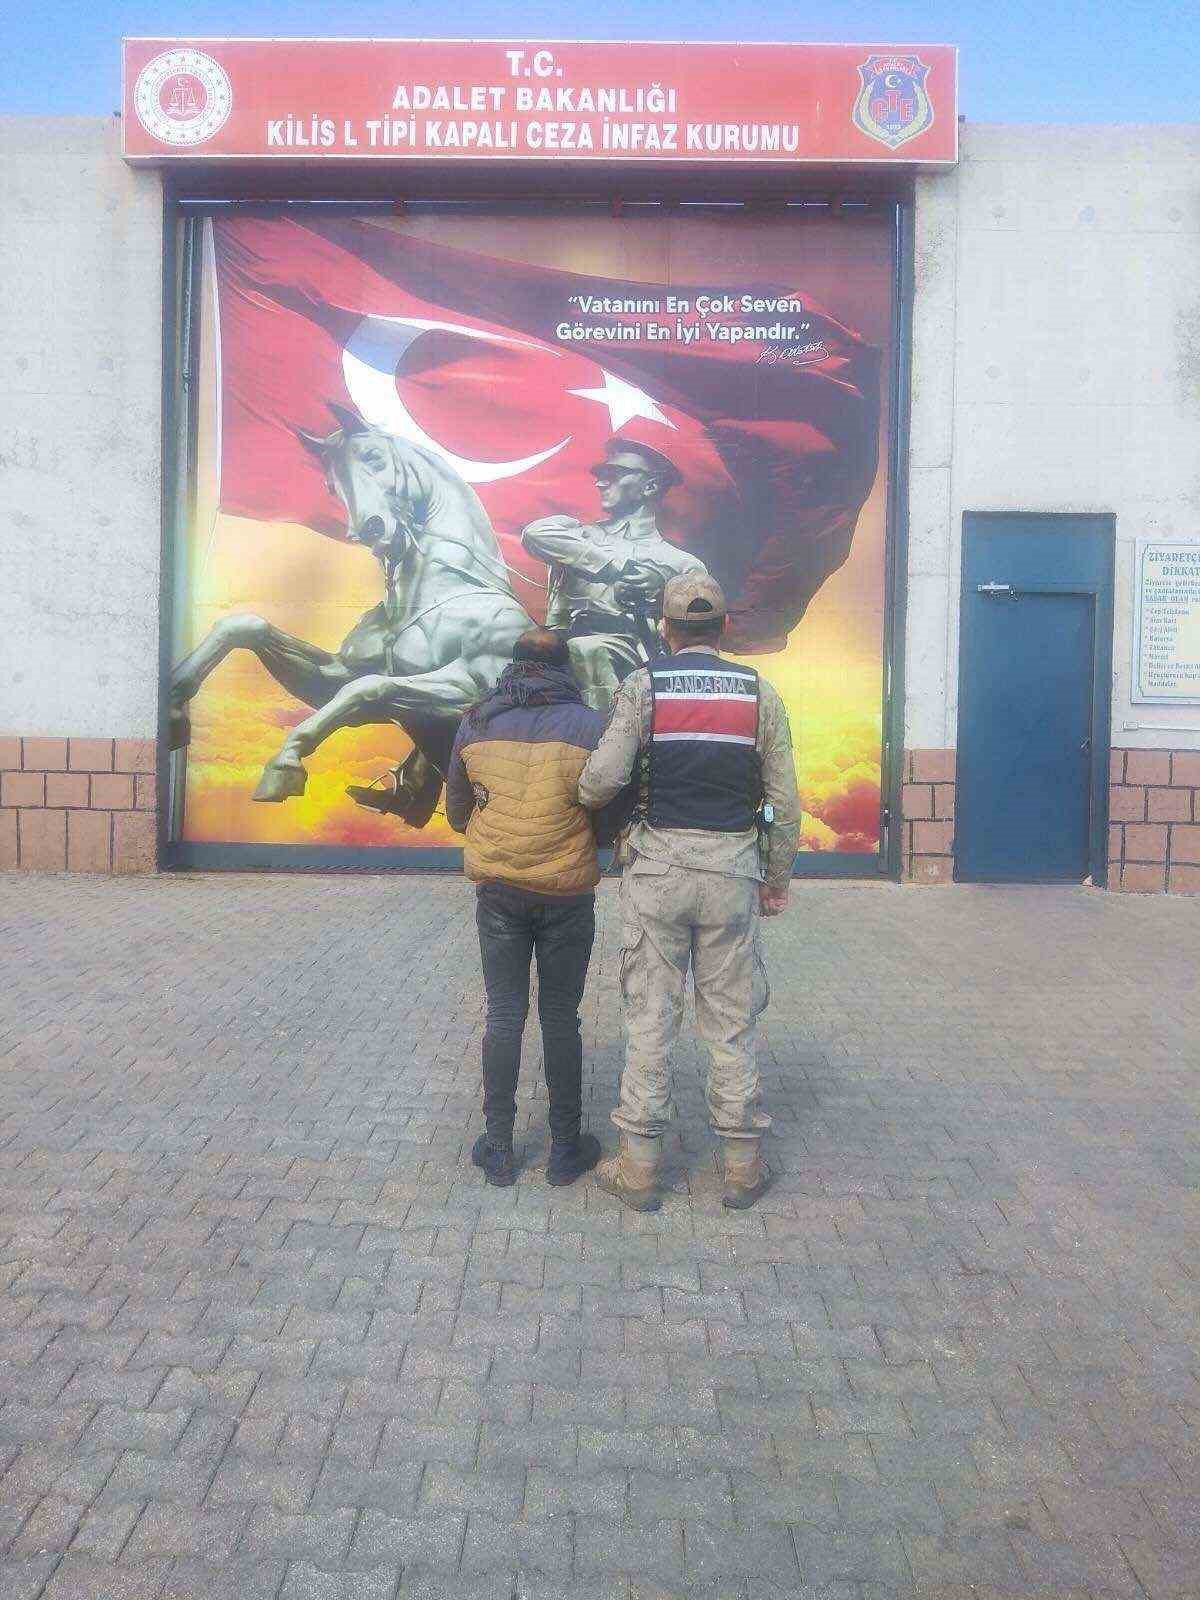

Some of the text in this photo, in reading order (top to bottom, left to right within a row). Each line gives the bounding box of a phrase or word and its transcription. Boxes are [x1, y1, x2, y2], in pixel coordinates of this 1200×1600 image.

[506, 50, 563, 78] T.C.
[392, 82, 677, 113] ADALET BAKANLIĞI
[266, 114, 800, 152] KİLİS L TİPİ KAPALI CEZA İNFAZ KURUMU
[666, 297, 689, 313] En
[695, 295, 734, 318] Çok
[740, 295, 801, 313] Seven
[555, 322, 641, 340] Görevini
[646, 323, 671, 340] En
[676, 318, 700, 344] İyi
[666, 677, 746, 693] JANDARMA
